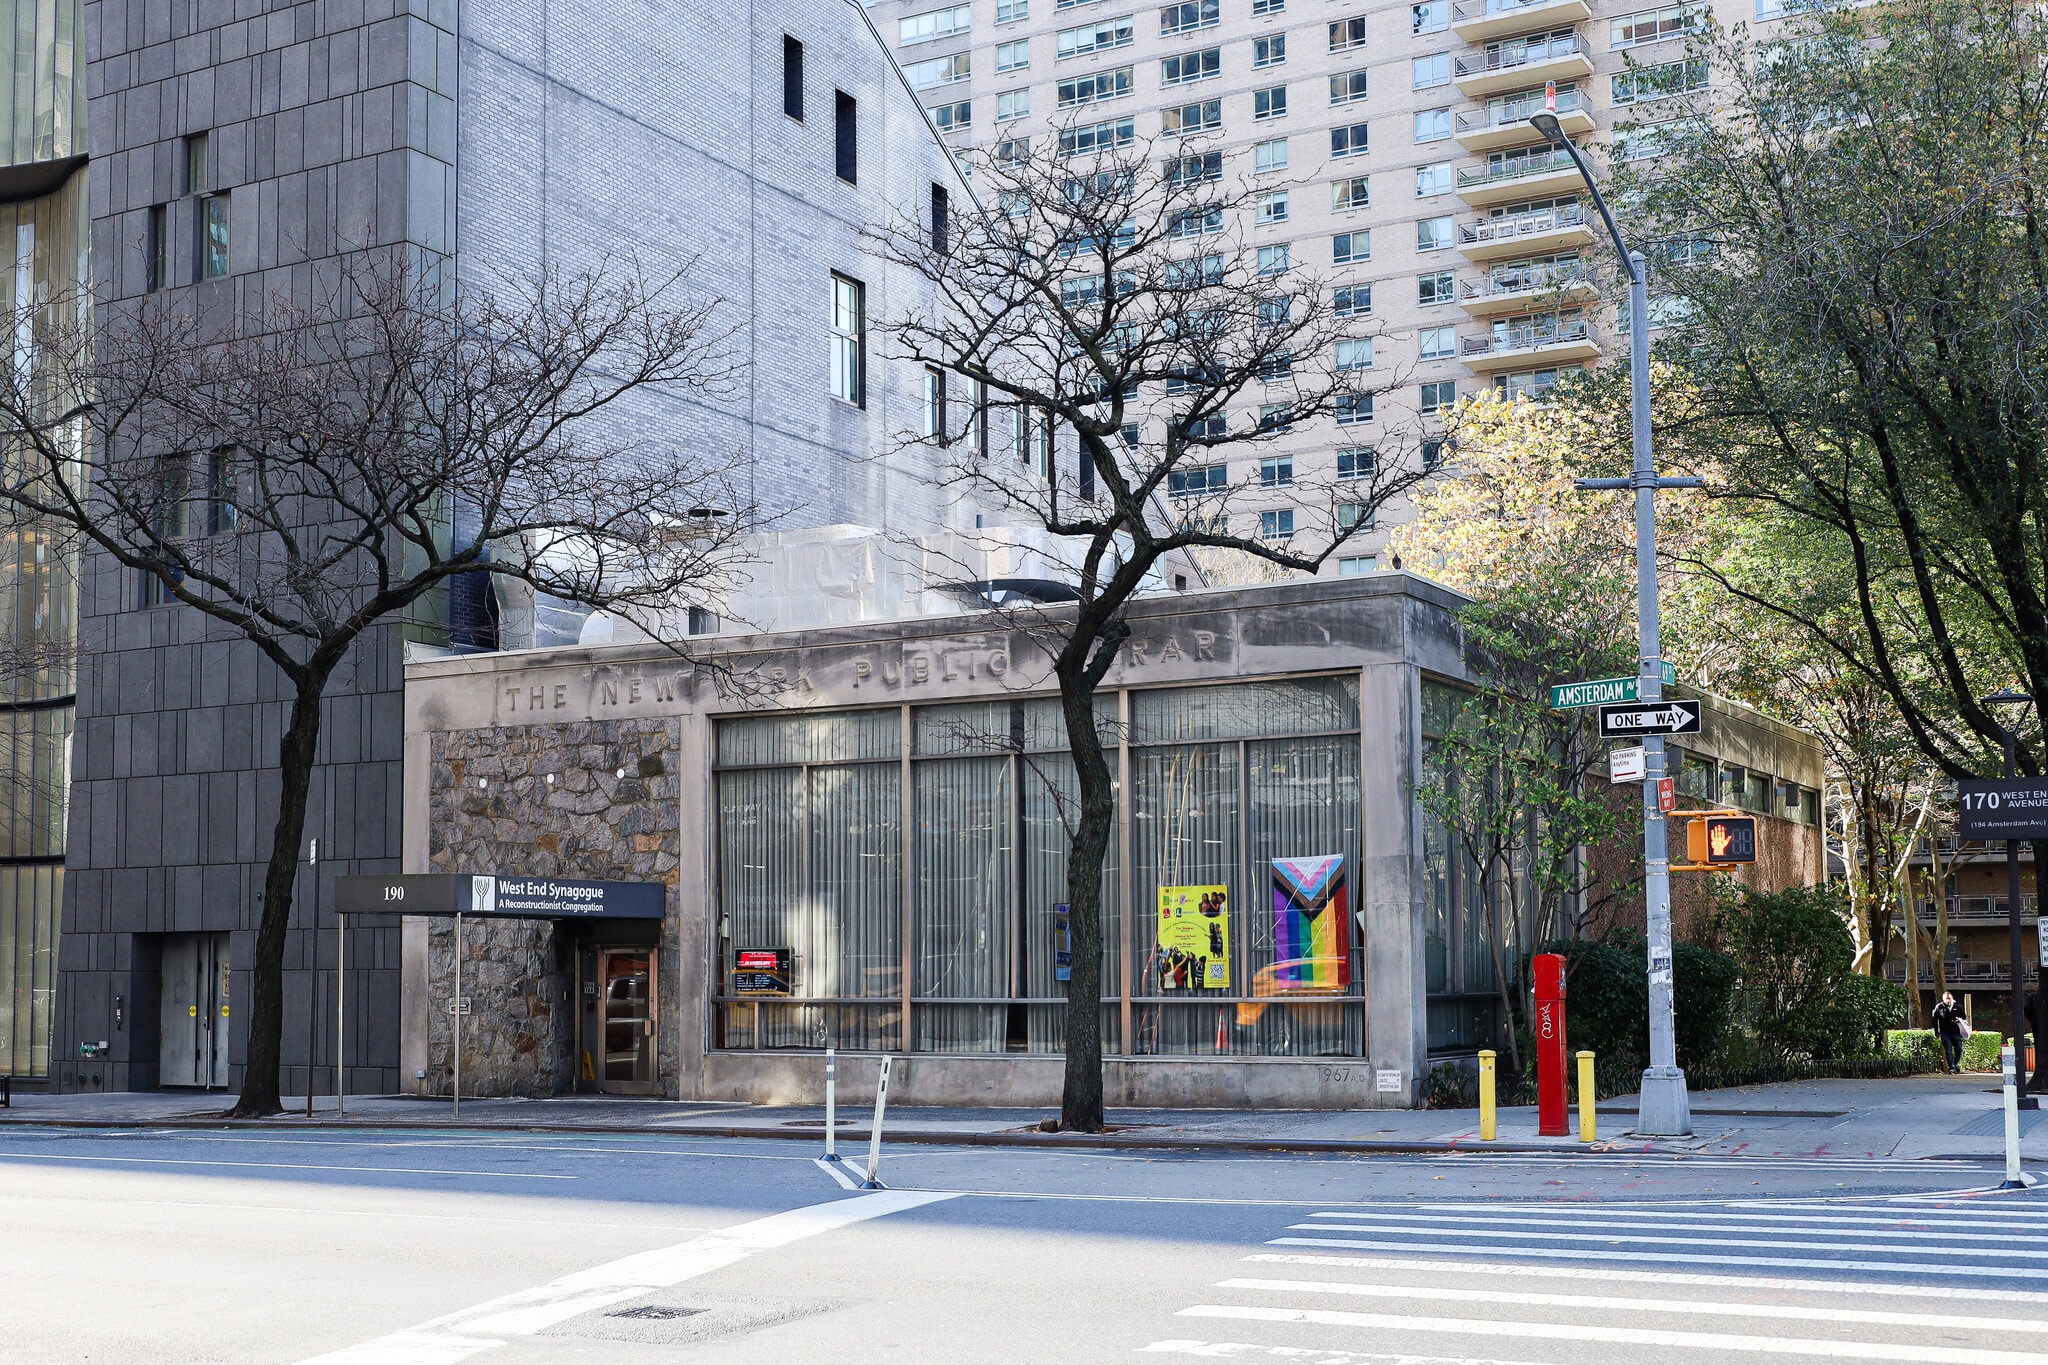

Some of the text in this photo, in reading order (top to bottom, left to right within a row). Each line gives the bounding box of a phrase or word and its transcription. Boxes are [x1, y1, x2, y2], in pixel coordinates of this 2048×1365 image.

[505, 683, 568, 712] THE
[602, 675, 679, 706] NEW
[852, 649, 1006, 689] PUBLIC
[1557, 680, 1636, 706] AMSTERDAM AV
[1614, 711, 1685, 727] ONE WAY
[1619, 751, 1637, 760] PARKING
[1962, 789, 2048, 811] 170 WEST EN
[2008, 799, 2048, 808] AVENUE
[1971, 821, 1986, 829] (194
[1987, 819, 2029, 828] Amsterdam
[383, 885, 405, 901] 190
[499, 880, 604, 902] West End Synagogue
[498, 899, 604, 913] A Reconstructionist Congregation
[1317, 1067, 1351, 1082] 1967
